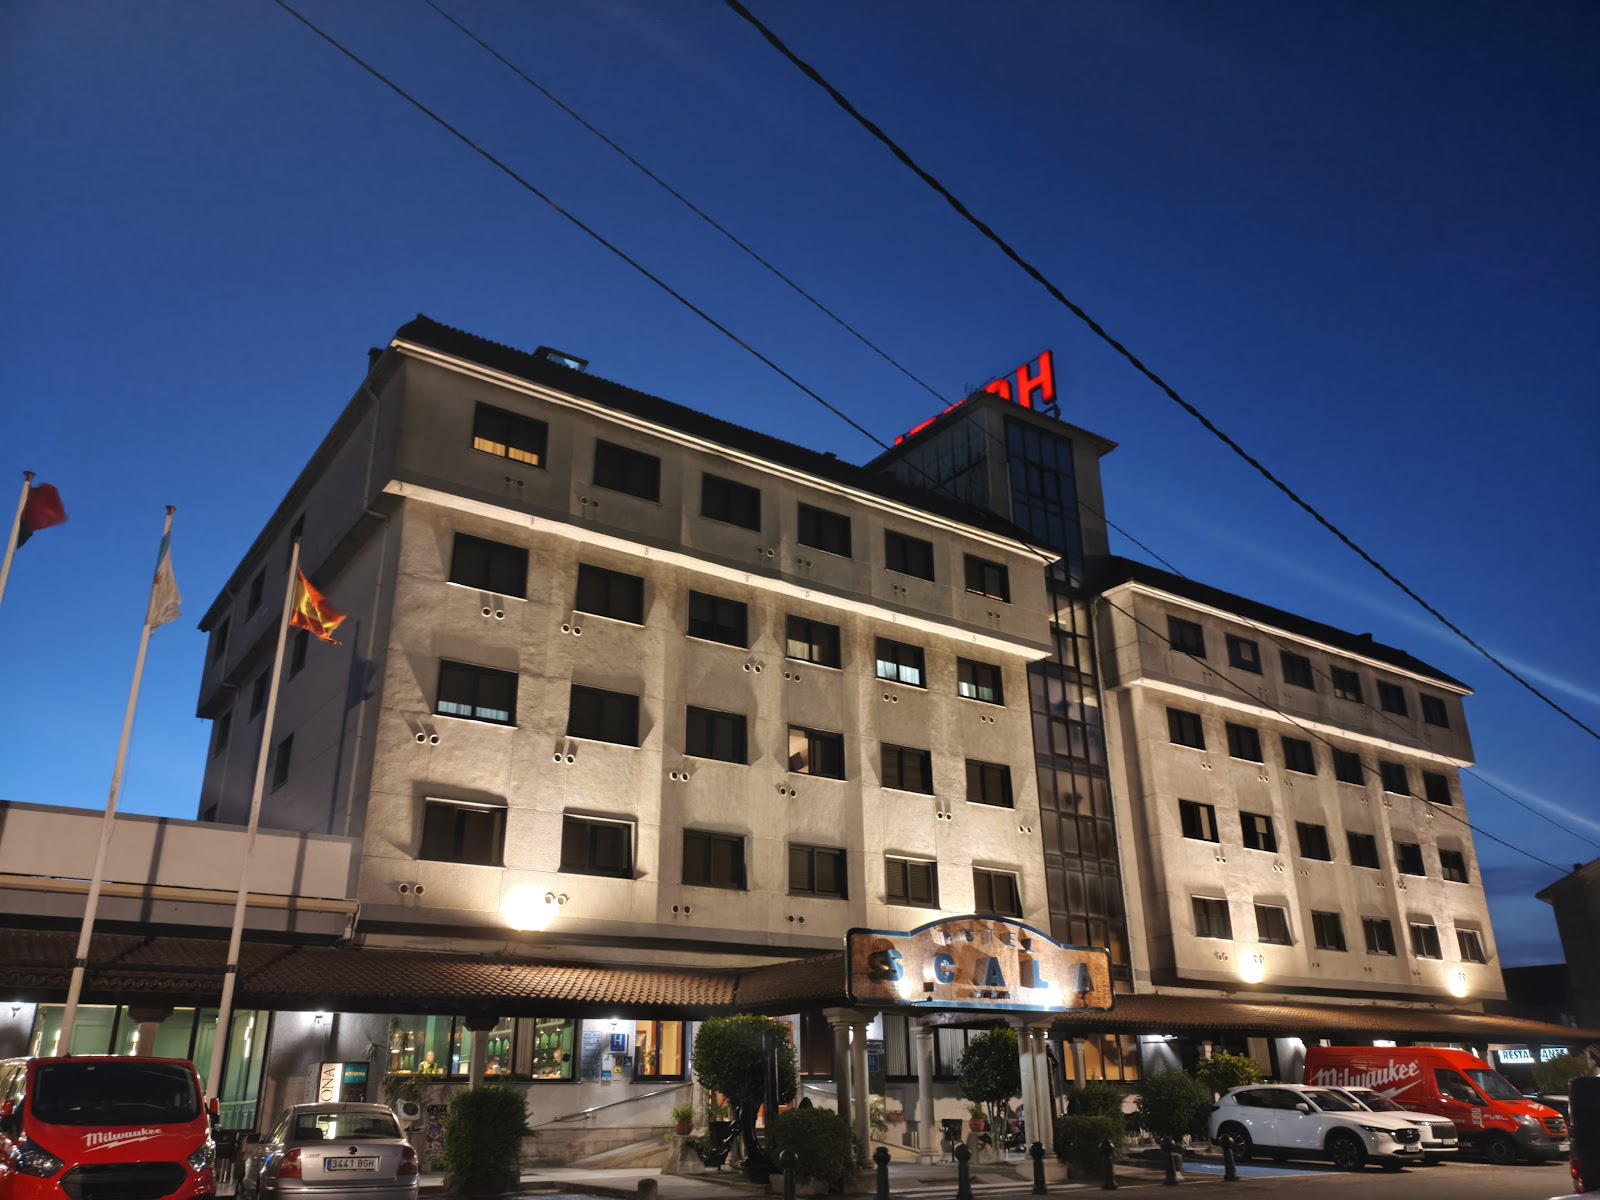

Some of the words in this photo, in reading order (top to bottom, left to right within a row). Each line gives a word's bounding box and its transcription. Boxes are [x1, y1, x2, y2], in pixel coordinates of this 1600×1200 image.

[872, 949, 1095, 992] SCALA
[1502, 1048, 1567, 1061] RESTAANTE
[81, 1127, 163, 1147] Milwaukee
[331, 1160, 354, 1169] 3441
[357, 1159, 375, 1168] BGH
